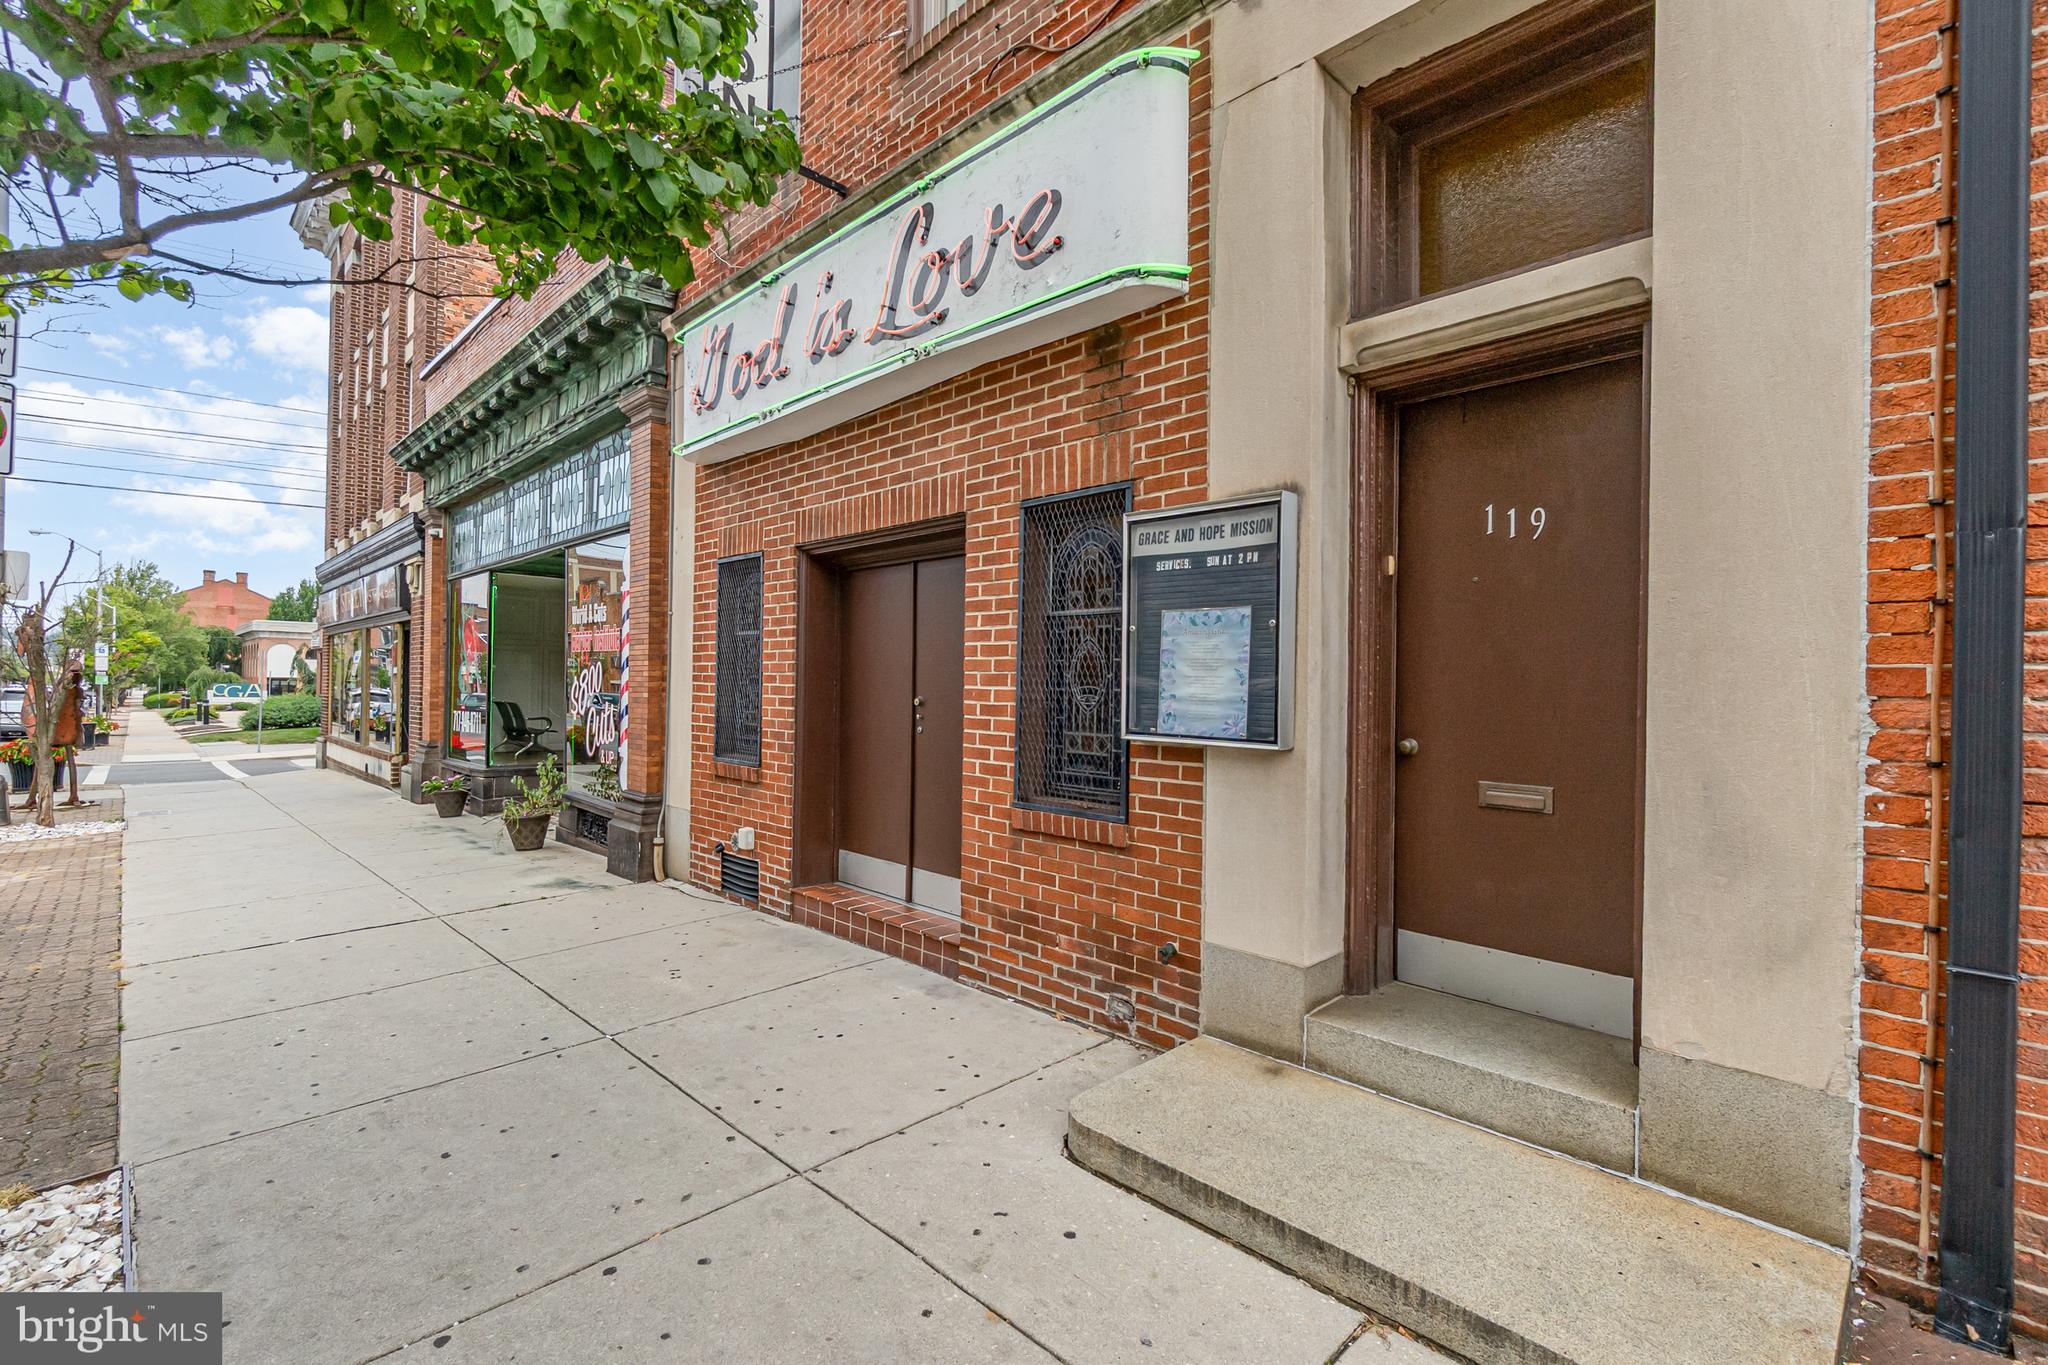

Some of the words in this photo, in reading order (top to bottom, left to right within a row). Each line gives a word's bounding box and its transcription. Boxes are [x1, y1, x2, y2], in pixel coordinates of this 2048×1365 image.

[690, 282, 798, 416] God
[803, 271, 857, 365] is
[863, 188, 1065, 346] Love
[1138, 530, 1170, 546] GRACE
[1174, 527, 1195, 543] AND
[1199, 524, 1225, 541] HOPE
[1230, 517, 1273, 538] MISSION
[1485, 504, 1546, 540] 119
[1206, 555, 1220, 567] SUN
[1222, 554, 1233, 566] AT
[1238, 552, 1244, 565] 2
[1246, 551, 1259, 564] PM
[213, 683, 261, 698] CGA
[586, 700, 616, 758] Cuts
[606, 751, 615, 764] UP
